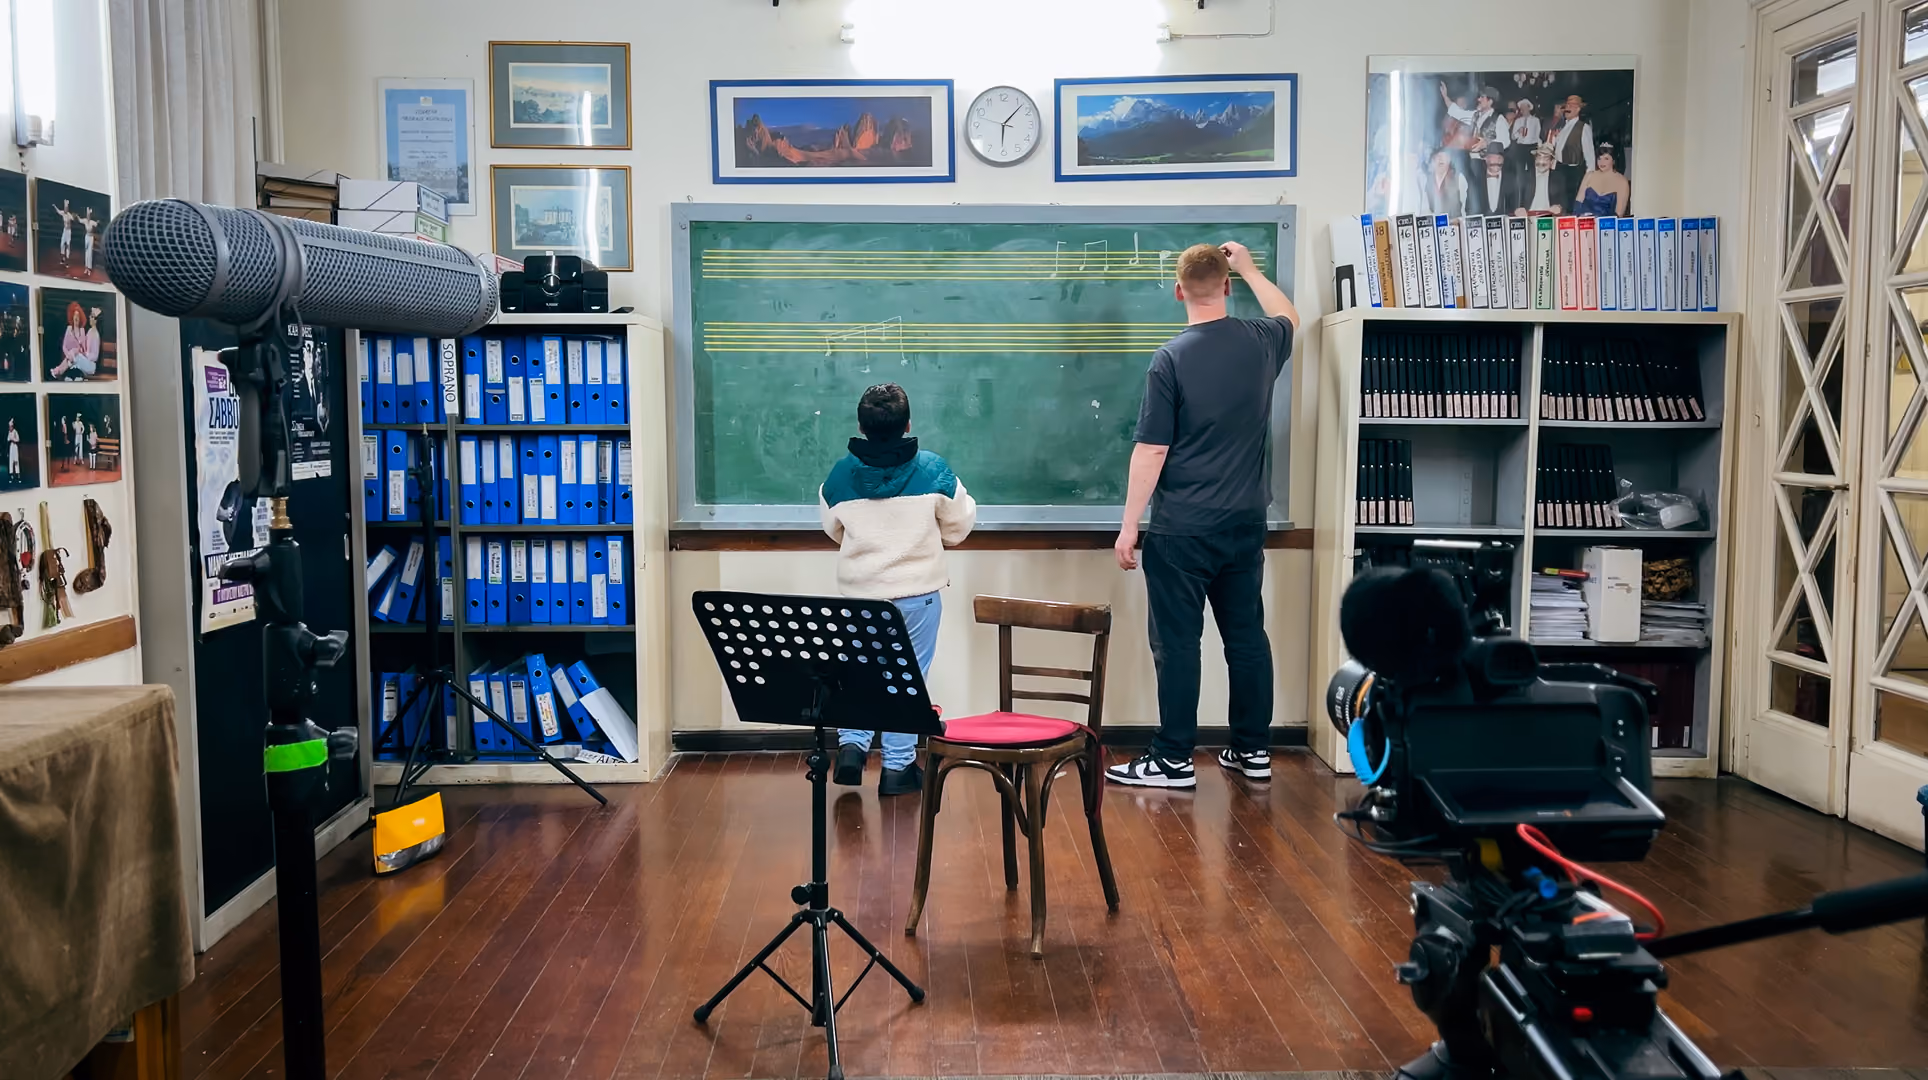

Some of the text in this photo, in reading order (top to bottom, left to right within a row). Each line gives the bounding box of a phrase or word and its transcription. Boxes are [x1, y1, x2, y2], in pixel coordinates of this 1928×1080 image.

[985, 97, 993, 107] 11
[999, 93, 1009, 102] 12
[976, 107, 986, 117] 10
[1024, 107, 1032, 117] 2
[973, 121, 980, 130] 9
[1028, 120, 1033, 130] 3
[1023, 134, 1030, 143] 4
[987, 144, 993, 153] 7
[1000, 147, 1008, 157] 6
[1014, 143, 1021, 153] 5
[1375, 225, 1385, 236] 18
[1400, 228, 1412, 239] 16
[1420, 228, 1431, 239] 15
[1469, 228, 1479, 239] 12
[1512, 232, 1522, 241] 10
[442, 343, 457, 403] SOPRANO
[209, 397, 241, 430] ΣΑΒΒΟ
